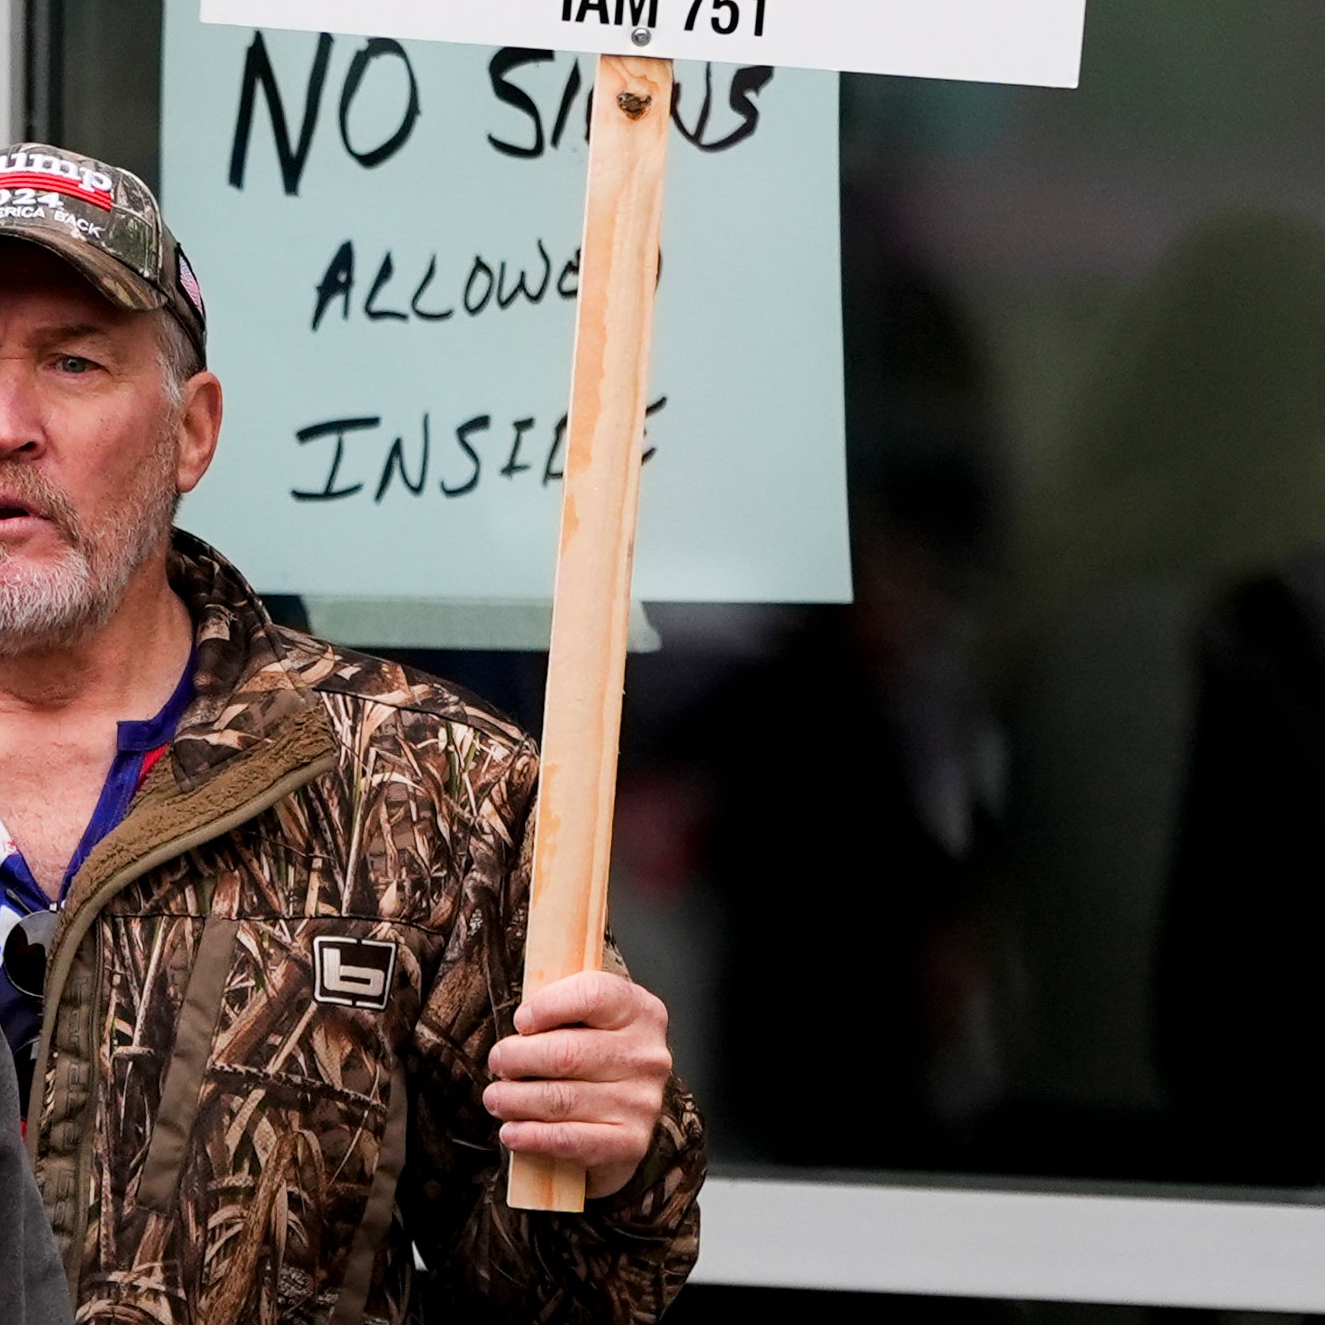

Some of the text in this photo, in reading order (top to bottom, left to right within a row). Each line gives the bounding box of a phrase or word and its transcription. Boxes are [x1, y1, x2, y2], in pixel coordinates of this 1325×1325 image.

[228, 33, 776, 197] NO SINS
[53, 209, 105, 239] BACK
